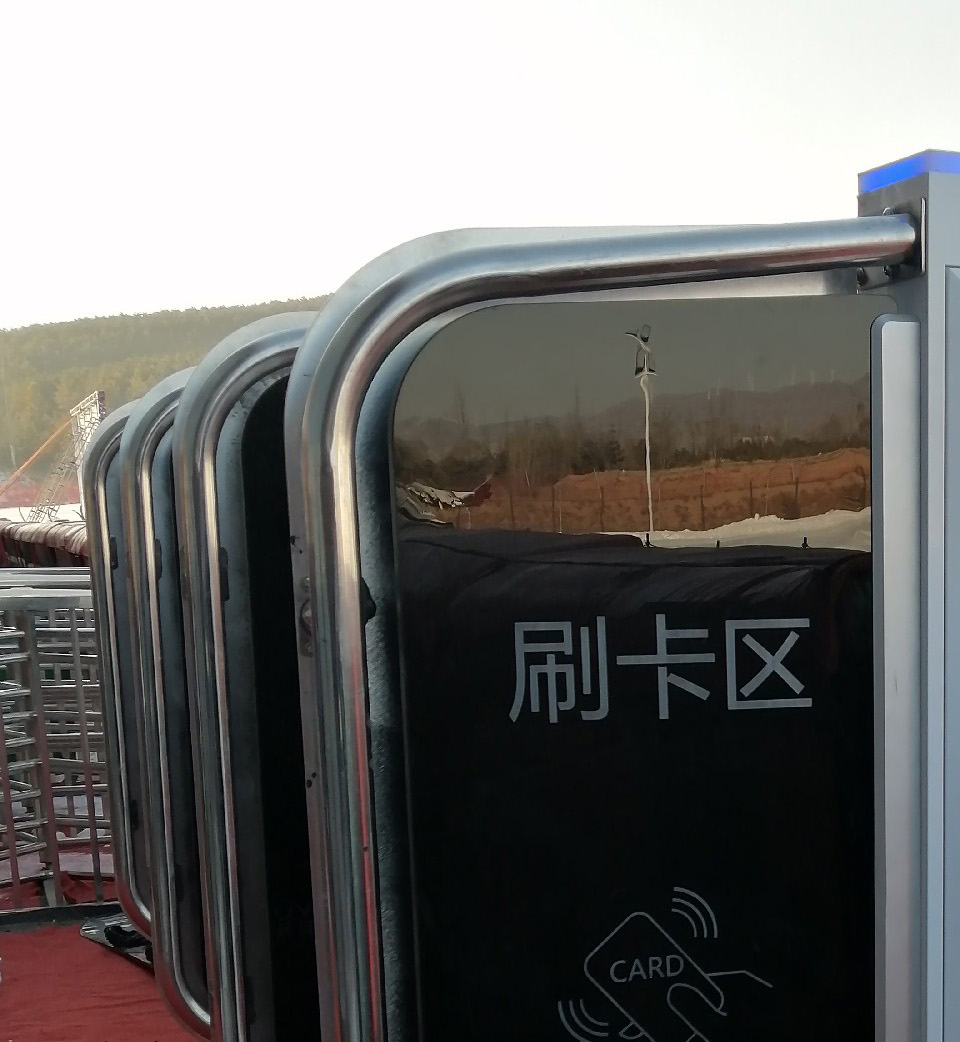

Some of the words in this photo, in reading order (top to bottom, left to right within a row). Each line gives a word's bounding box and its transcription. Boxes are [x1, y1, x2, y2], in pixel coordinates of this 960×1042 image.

[508, 613, 813, 723] 刷卡区
[609, 954, 684, 984] CARD
